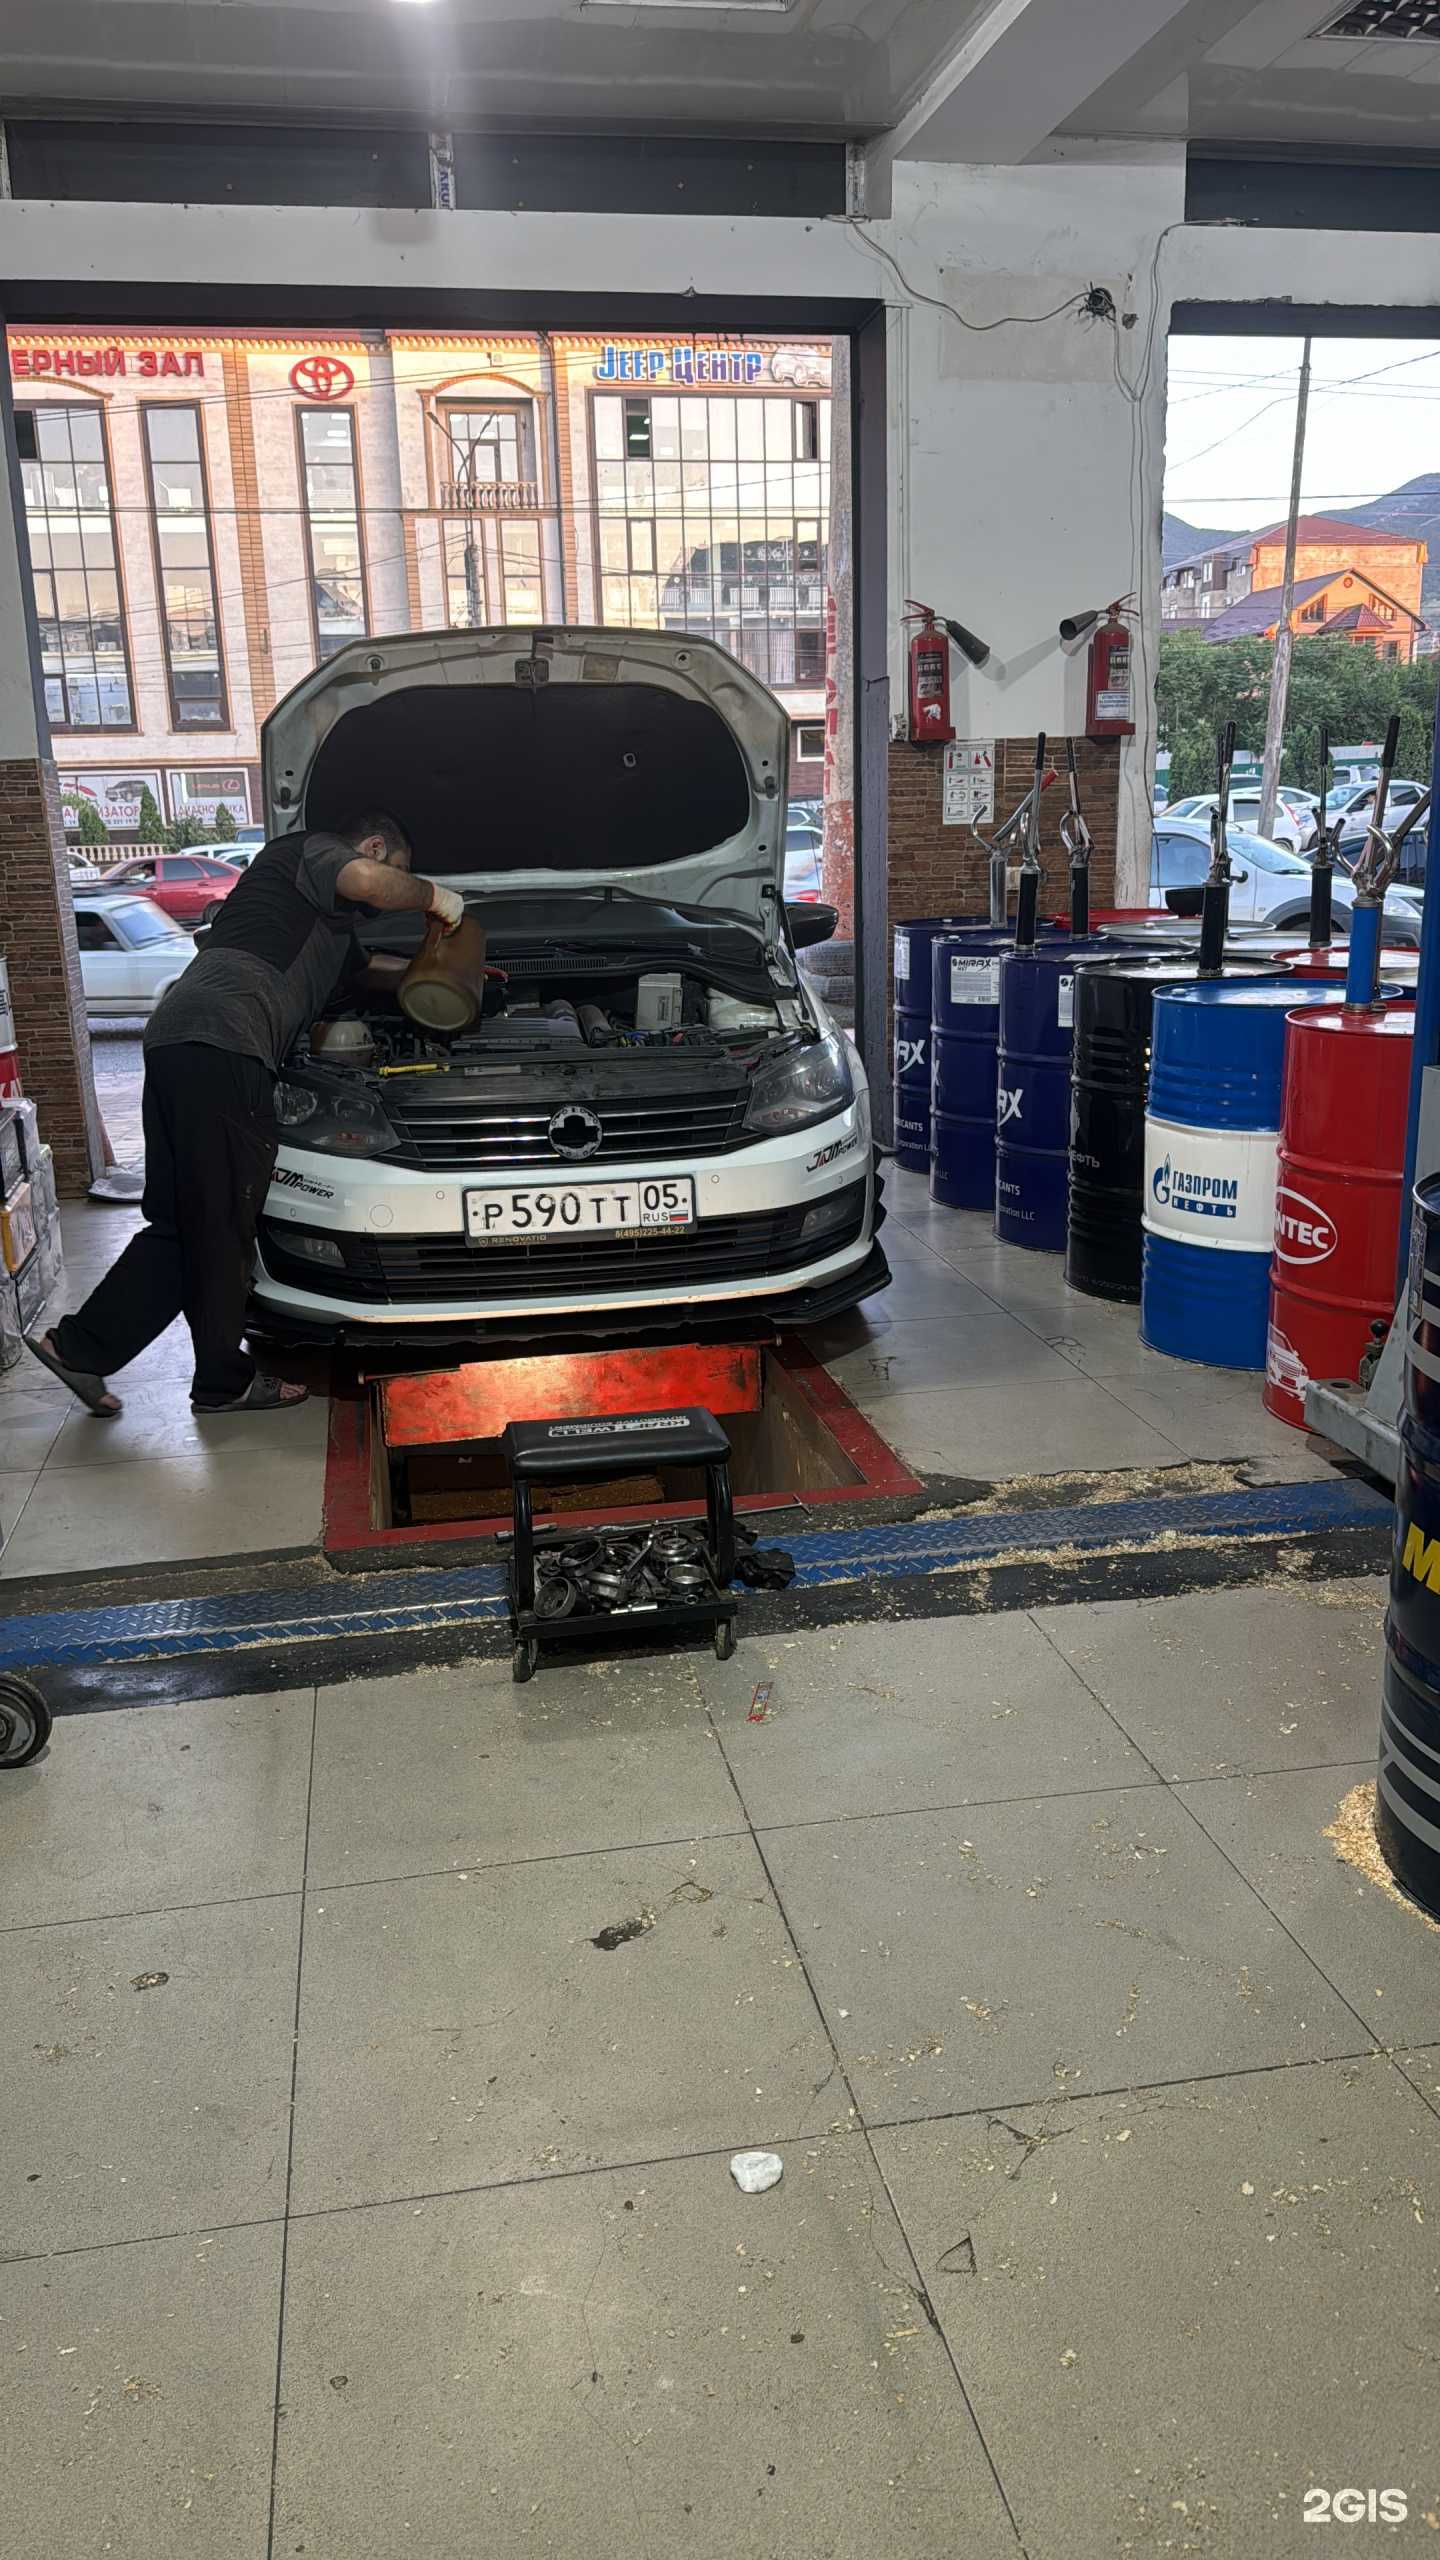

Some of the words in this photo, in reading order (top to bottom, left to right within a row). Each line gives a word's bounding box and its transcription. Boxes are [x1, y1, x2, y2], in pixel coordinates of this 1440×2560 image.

[138, 351, 205, 378] ЗАЛ
[958, 958, 991, 973] MIRAX
[294, 1181, 335, 1199] POWER
[1172, 1170, 1238, 1200] ГАЗПРОМ
[643, 1210, 669, 1222] RUS
[1173, 1196, 1234, 1217] НЕФТЬ
